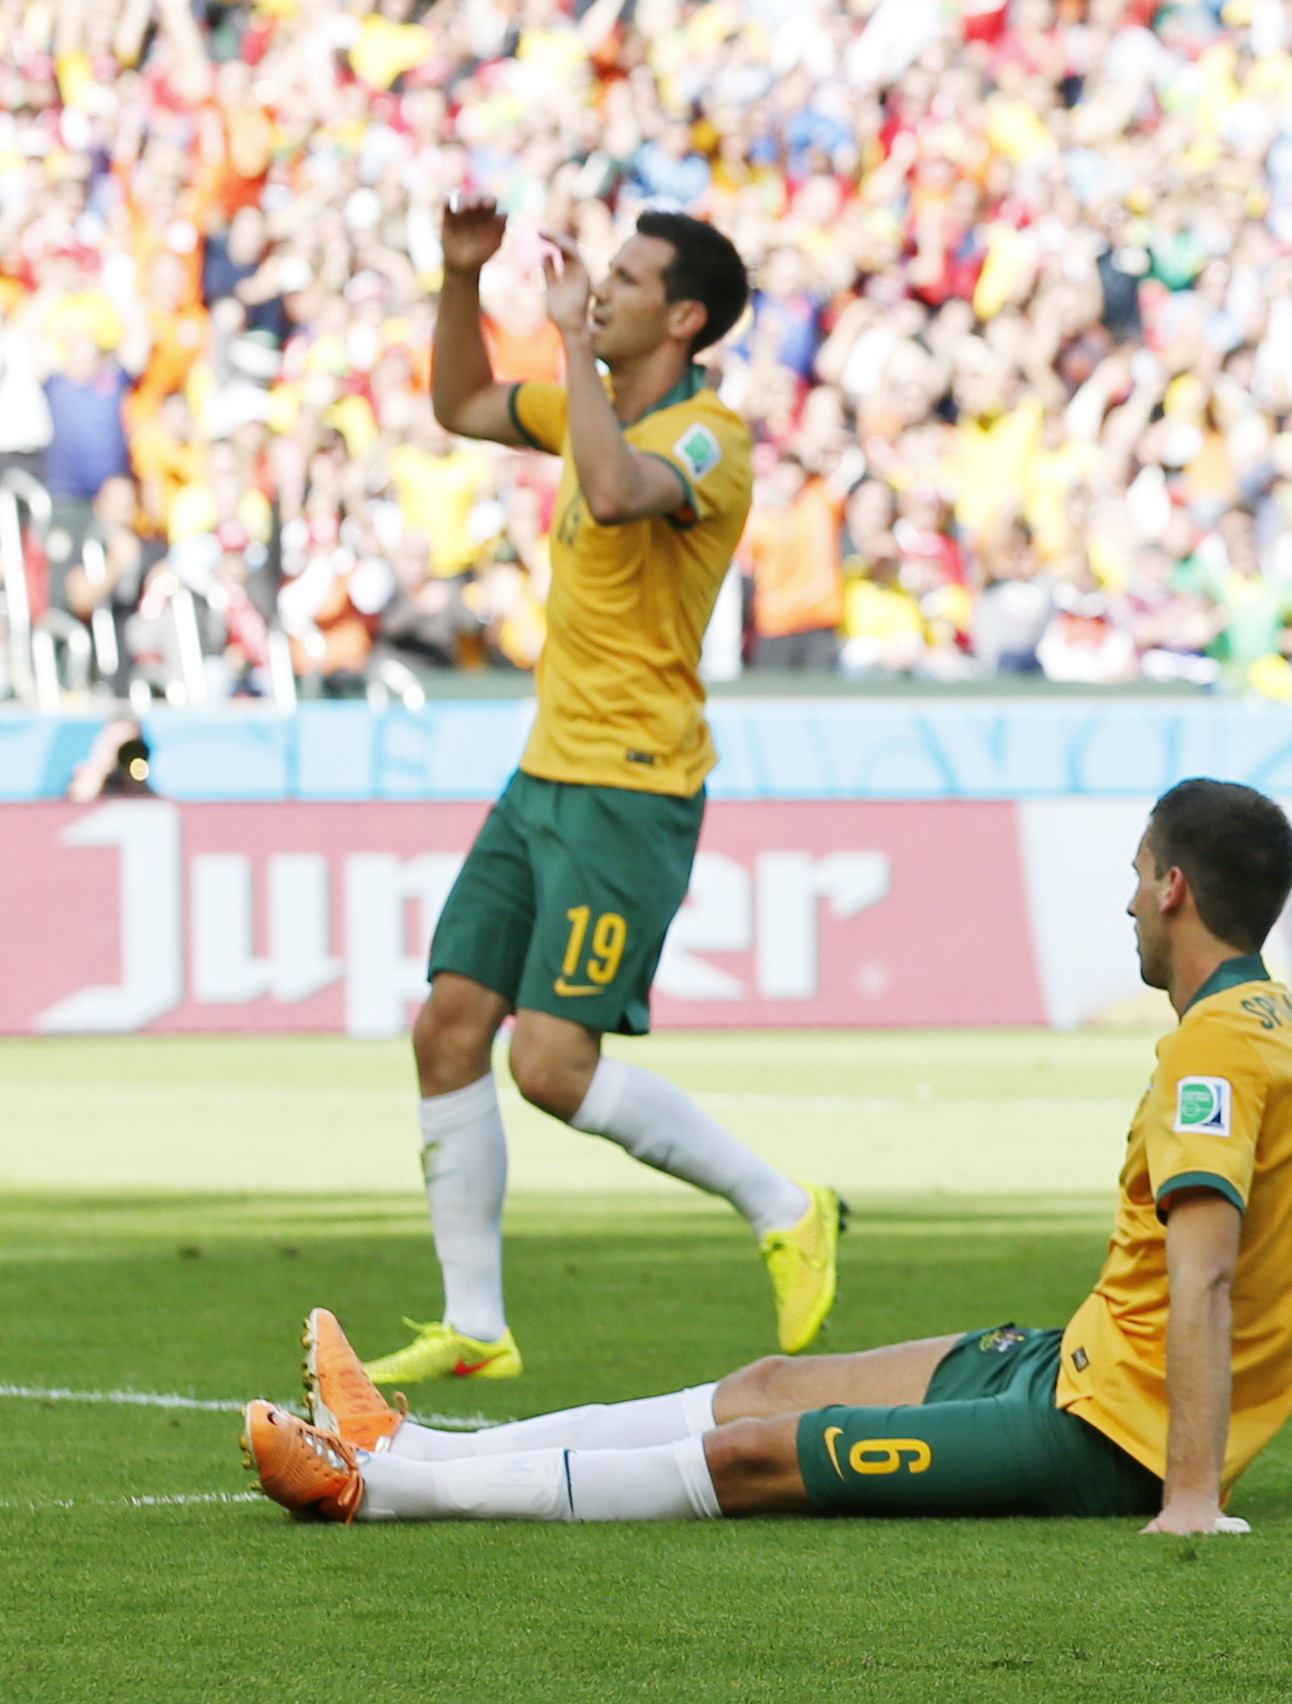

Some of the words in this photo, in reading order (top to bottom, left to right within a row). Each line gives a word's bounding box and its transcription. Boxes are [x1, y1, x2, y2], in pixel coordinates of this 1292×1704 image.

[32, 798, 891, 1038] Juper
[563, 905, 627, 984] 19
[849, 1438, 932, 1475] 6
